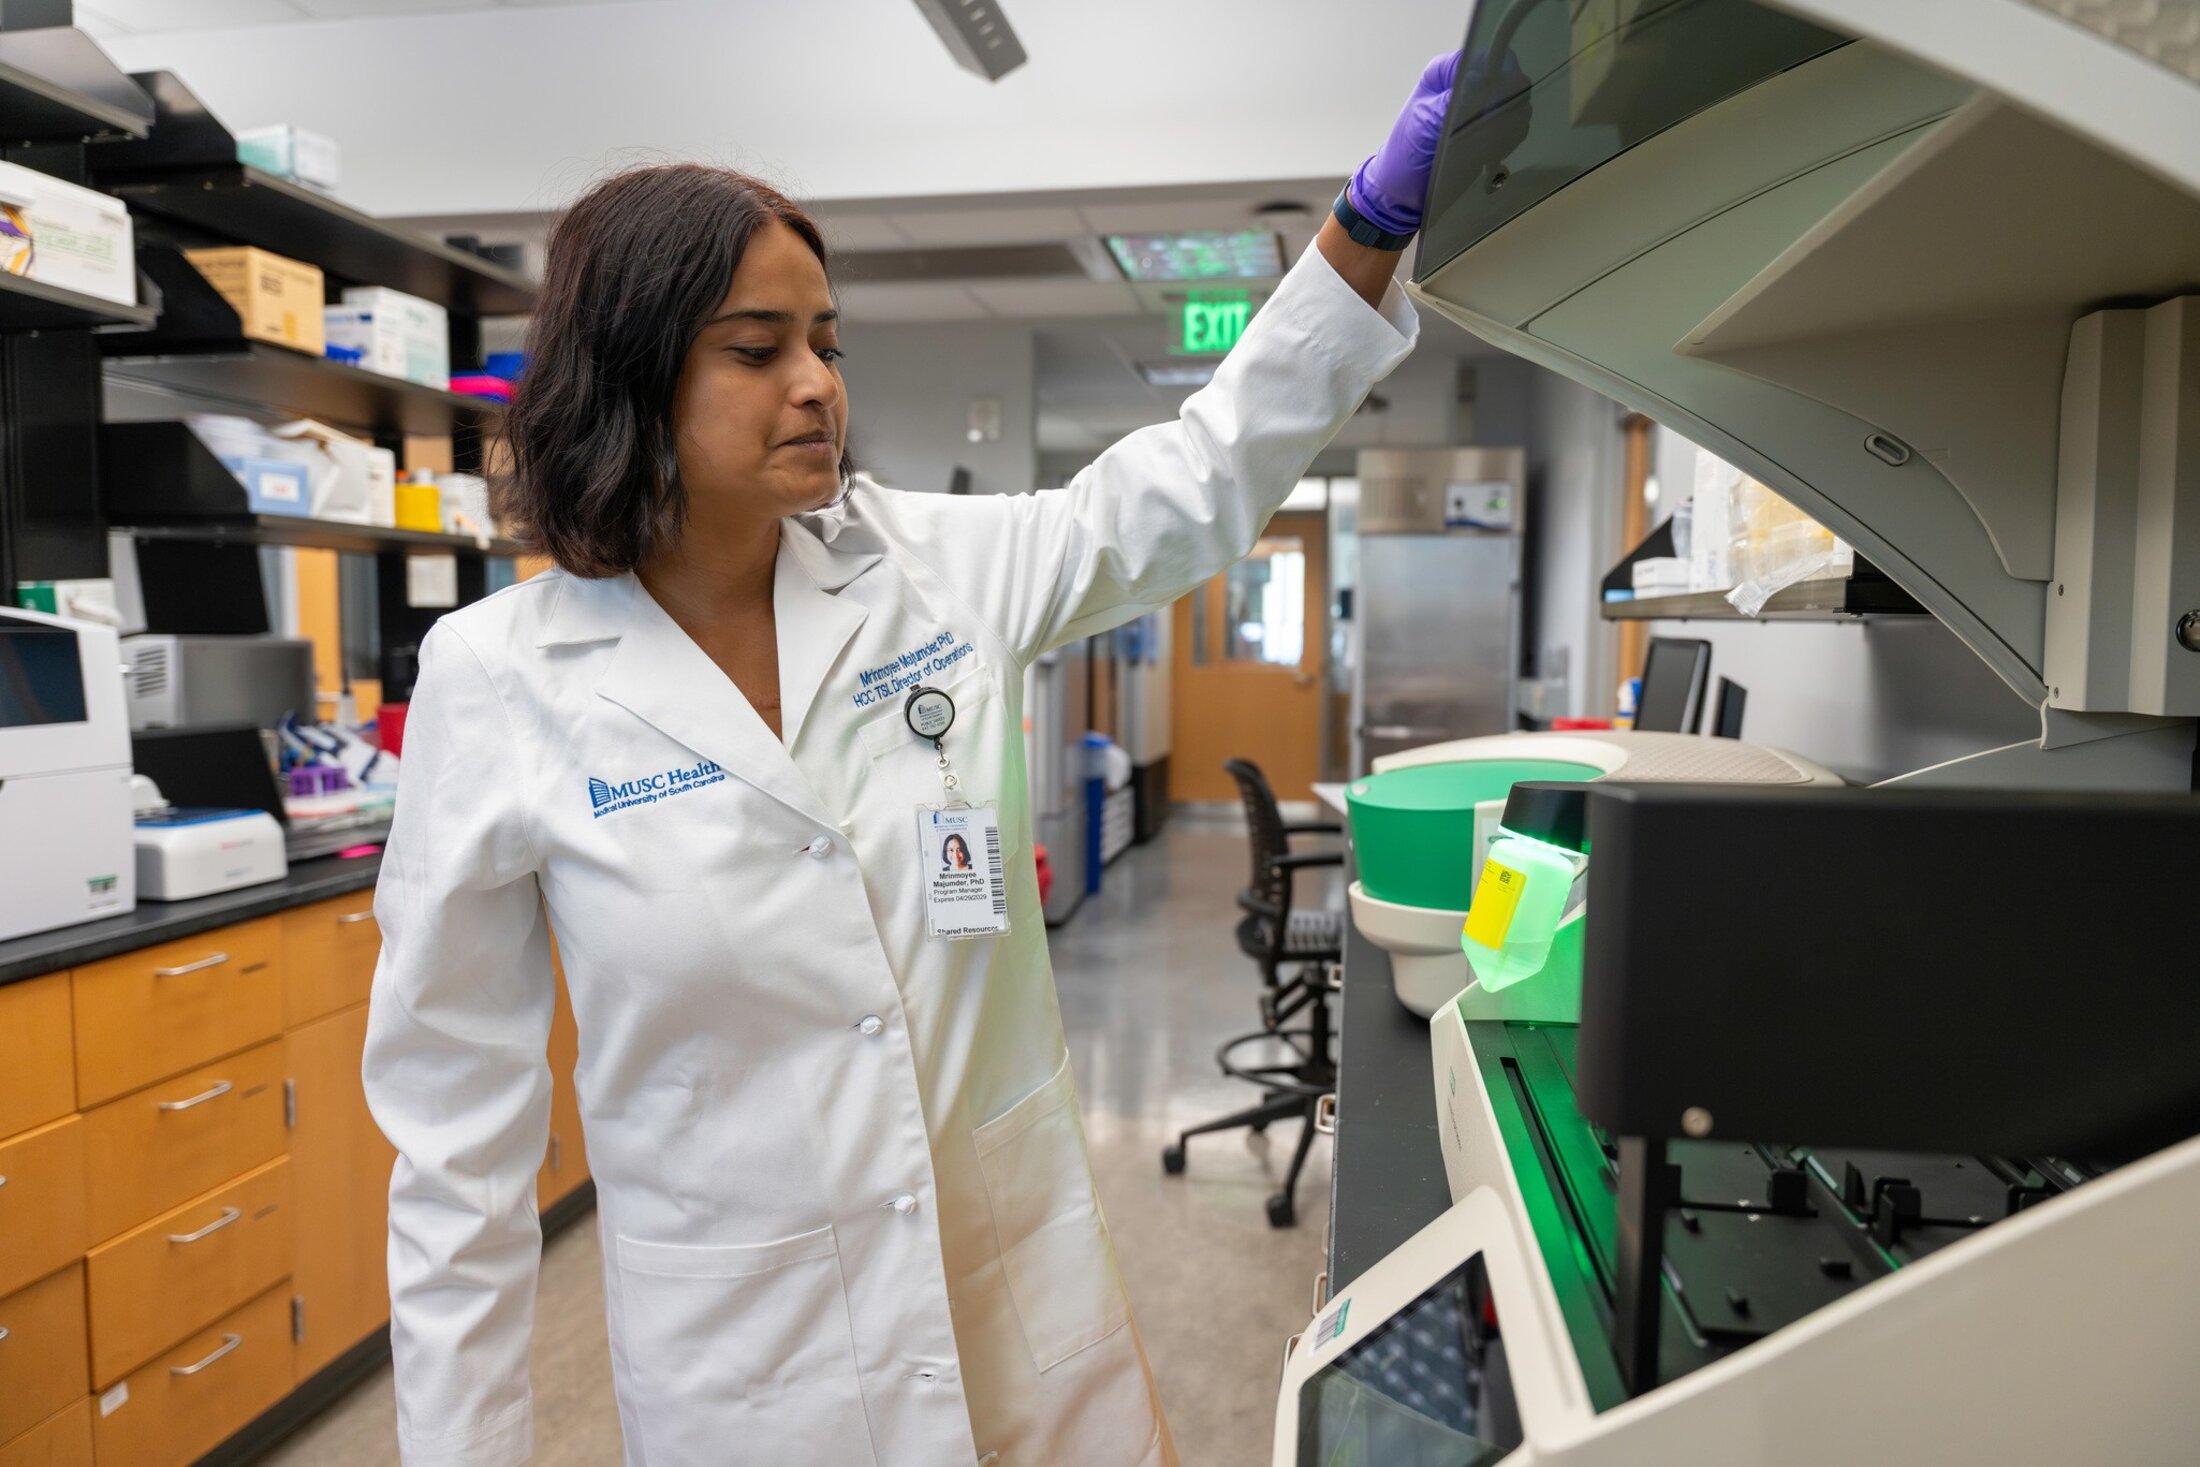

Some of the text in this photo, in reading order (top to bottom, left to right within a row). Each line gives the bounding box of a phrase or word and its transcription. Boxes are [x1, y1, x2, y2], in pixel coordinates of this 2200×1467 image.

[1184, 301, 1250, 351] EXIT
[853, 643, 974, 708] HCC TSL Director of Operations
[859, 661, 902, 687] Mrinmoyee
[937, 631, 955, 649] PhD
[593, 774, 725, 819] Medical University of South Carolina
[610, 760, 722, 800] MUSC Health
[945, 816, 968, 824] MUSC
[933, 879, 969, 888] Majumder,
[939, 872, 977, 880] Mrinmoyee
[937, 927, 961, 935] Shared
